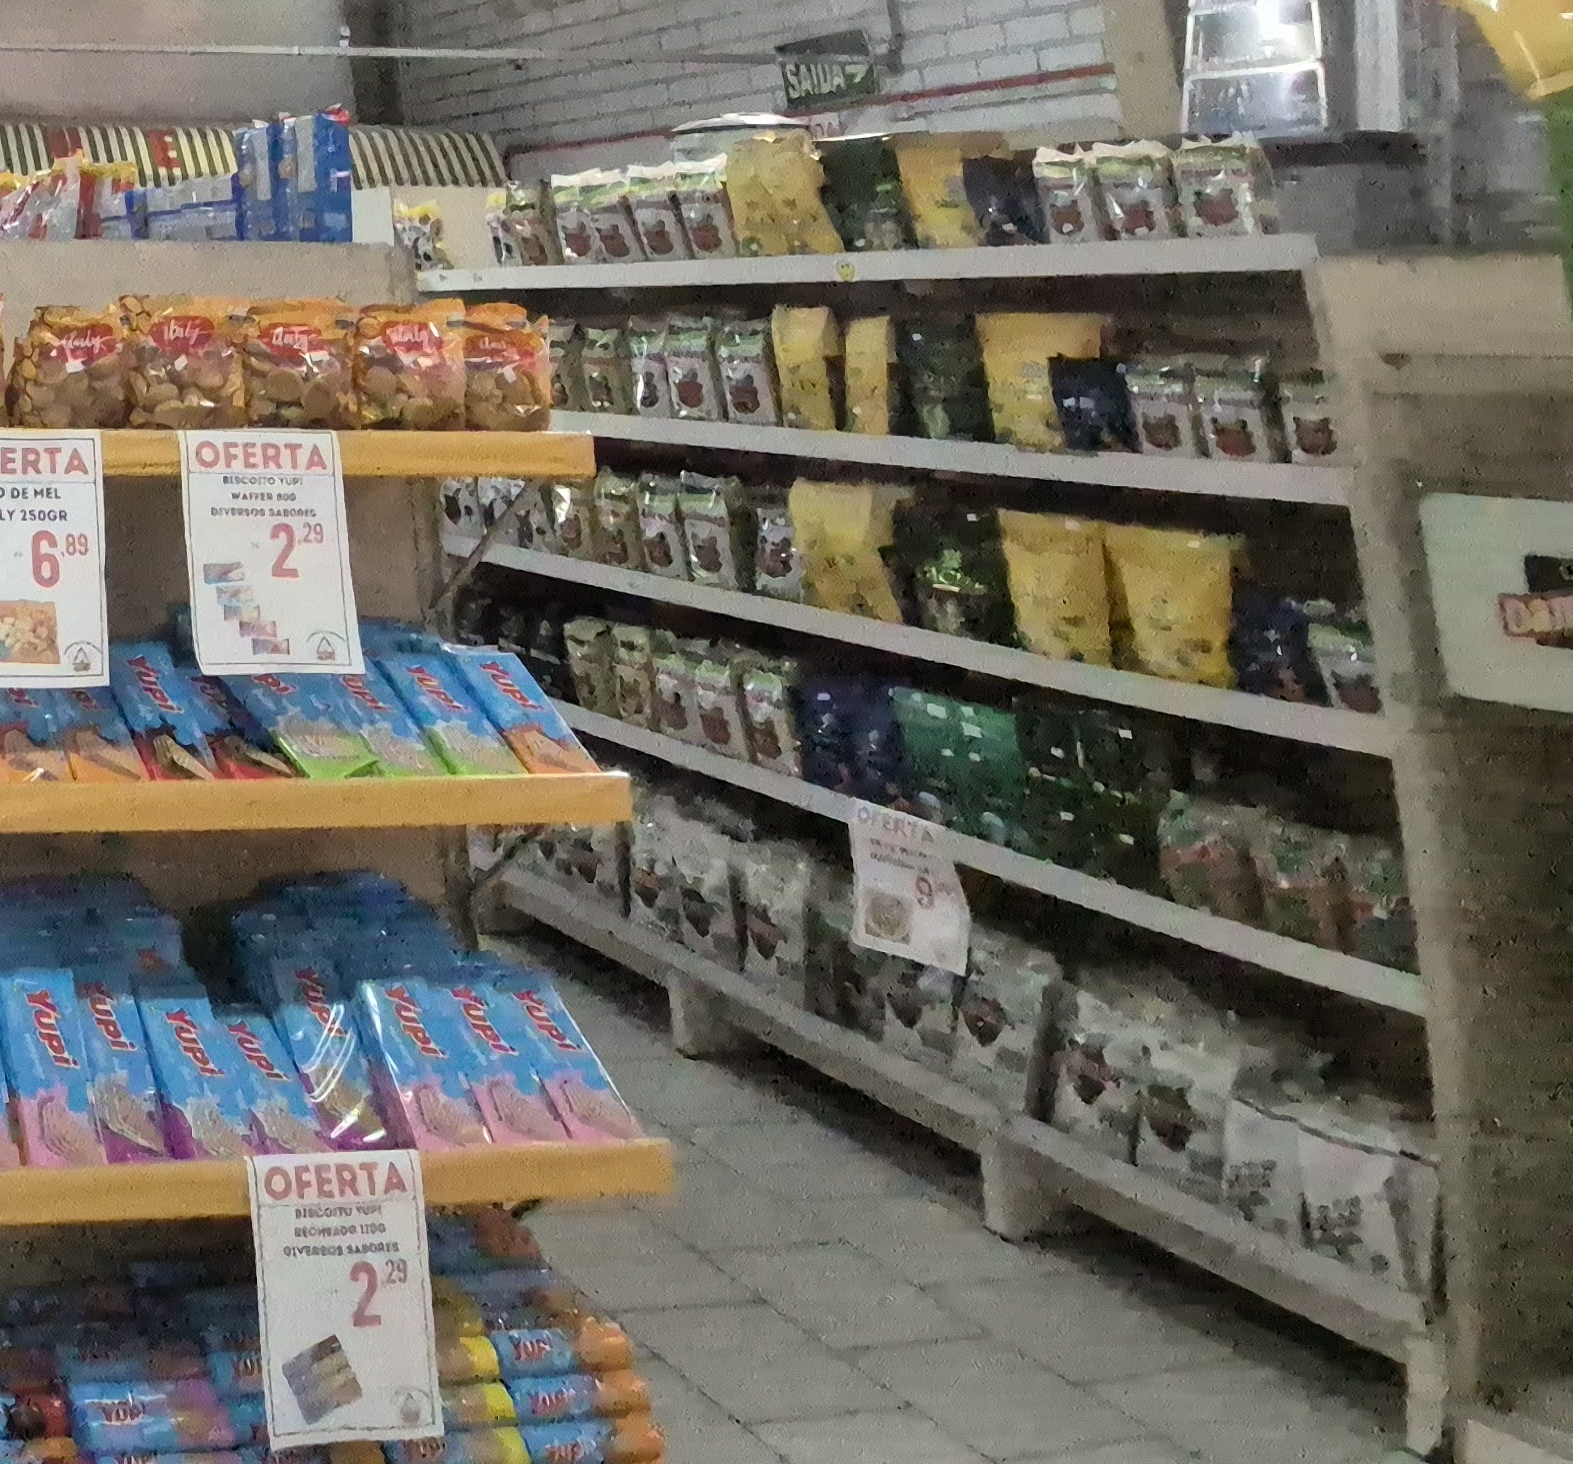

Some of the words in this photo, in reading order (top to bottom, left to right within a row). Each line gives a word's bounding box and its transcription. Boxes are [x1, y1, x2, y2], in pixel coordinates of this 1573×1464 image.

[195, 440, 328, 471] OFERTA
[10, 487, 29, 499] DE
[33, 488, 61, 499] MEL
[20, 509, 68, 521] 250GR
[264, 1161, 407, 1200] OFERTA
